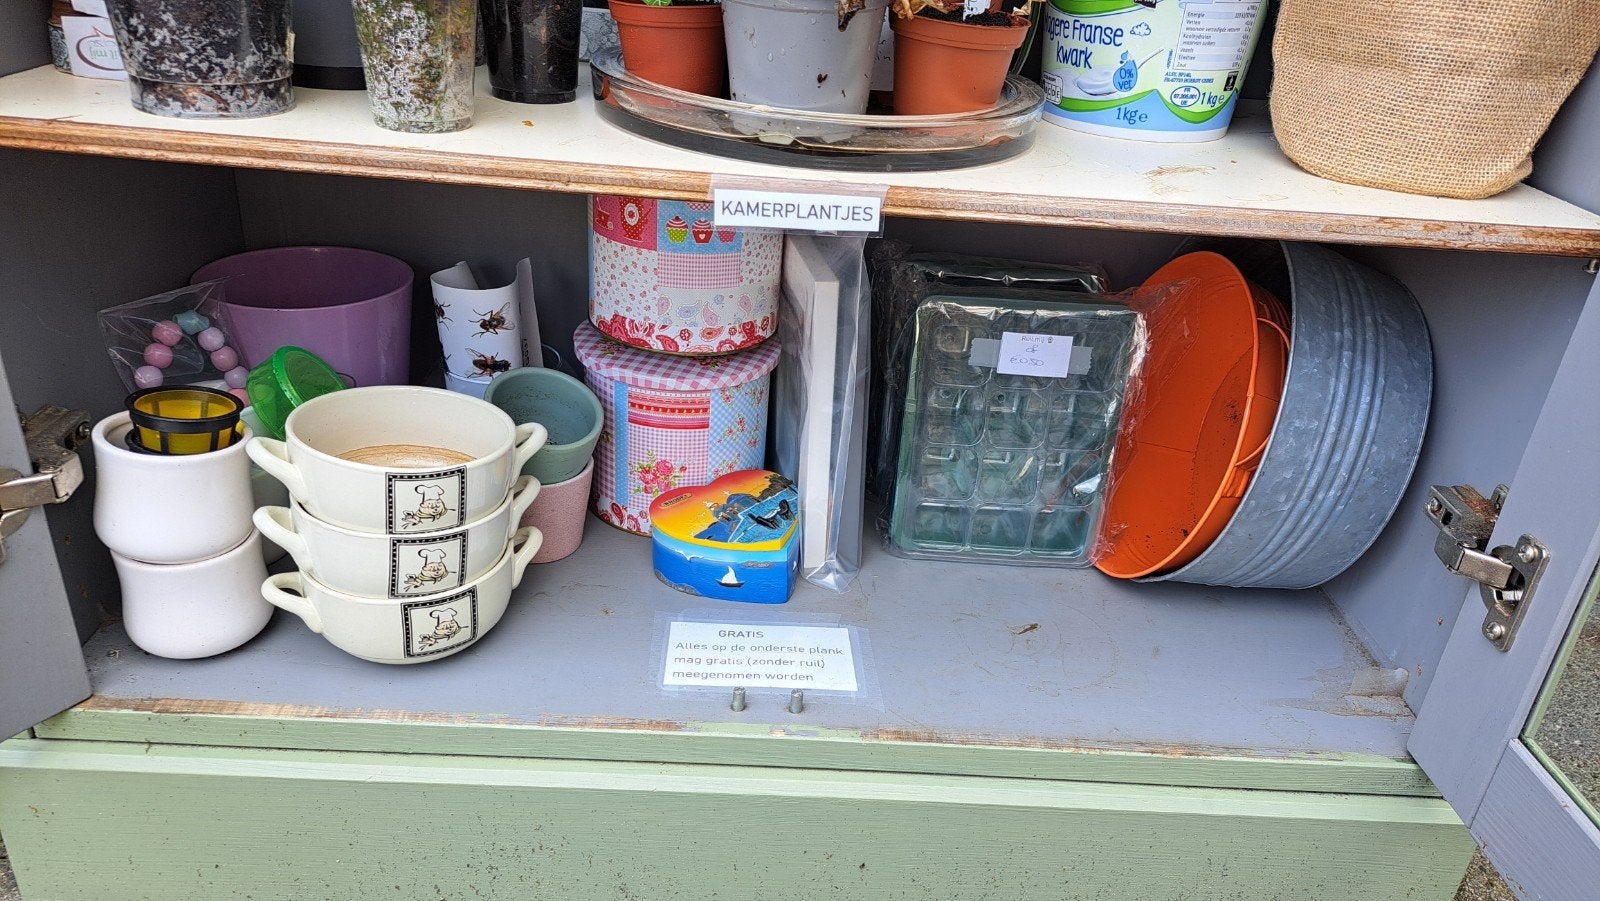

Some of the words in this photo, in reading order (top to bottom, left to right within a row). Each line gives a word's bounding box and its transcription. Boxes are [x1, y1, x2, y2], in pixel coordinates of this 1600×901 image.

[1072, 19, 1124, 47] Franse
[1056, 41, 1092, 69] kwark
[1120, 68, 1134, 80] 0%
[1118, 80, 1132, 90] vet
[721, 200, 873, 221] KAMERPLANTJES
[718, 630, 764, 638] GRATIS
[676, 642, 708, 650] Alles
[712, 644, 727, 653] op
[730, 643, 746, 652] de
[750, 644, 805, 653] onderste
[809, 646, 844, 655] plank
[674, 657, 702, 665] mag
[706, 656, 743, 665] gratis
[747, 658, 795, 667] (zonder
[799, 659, 826, 668] ruil)
[672, 671, 761, 680] meegenomen
[765, 672, 814, 681] worden
